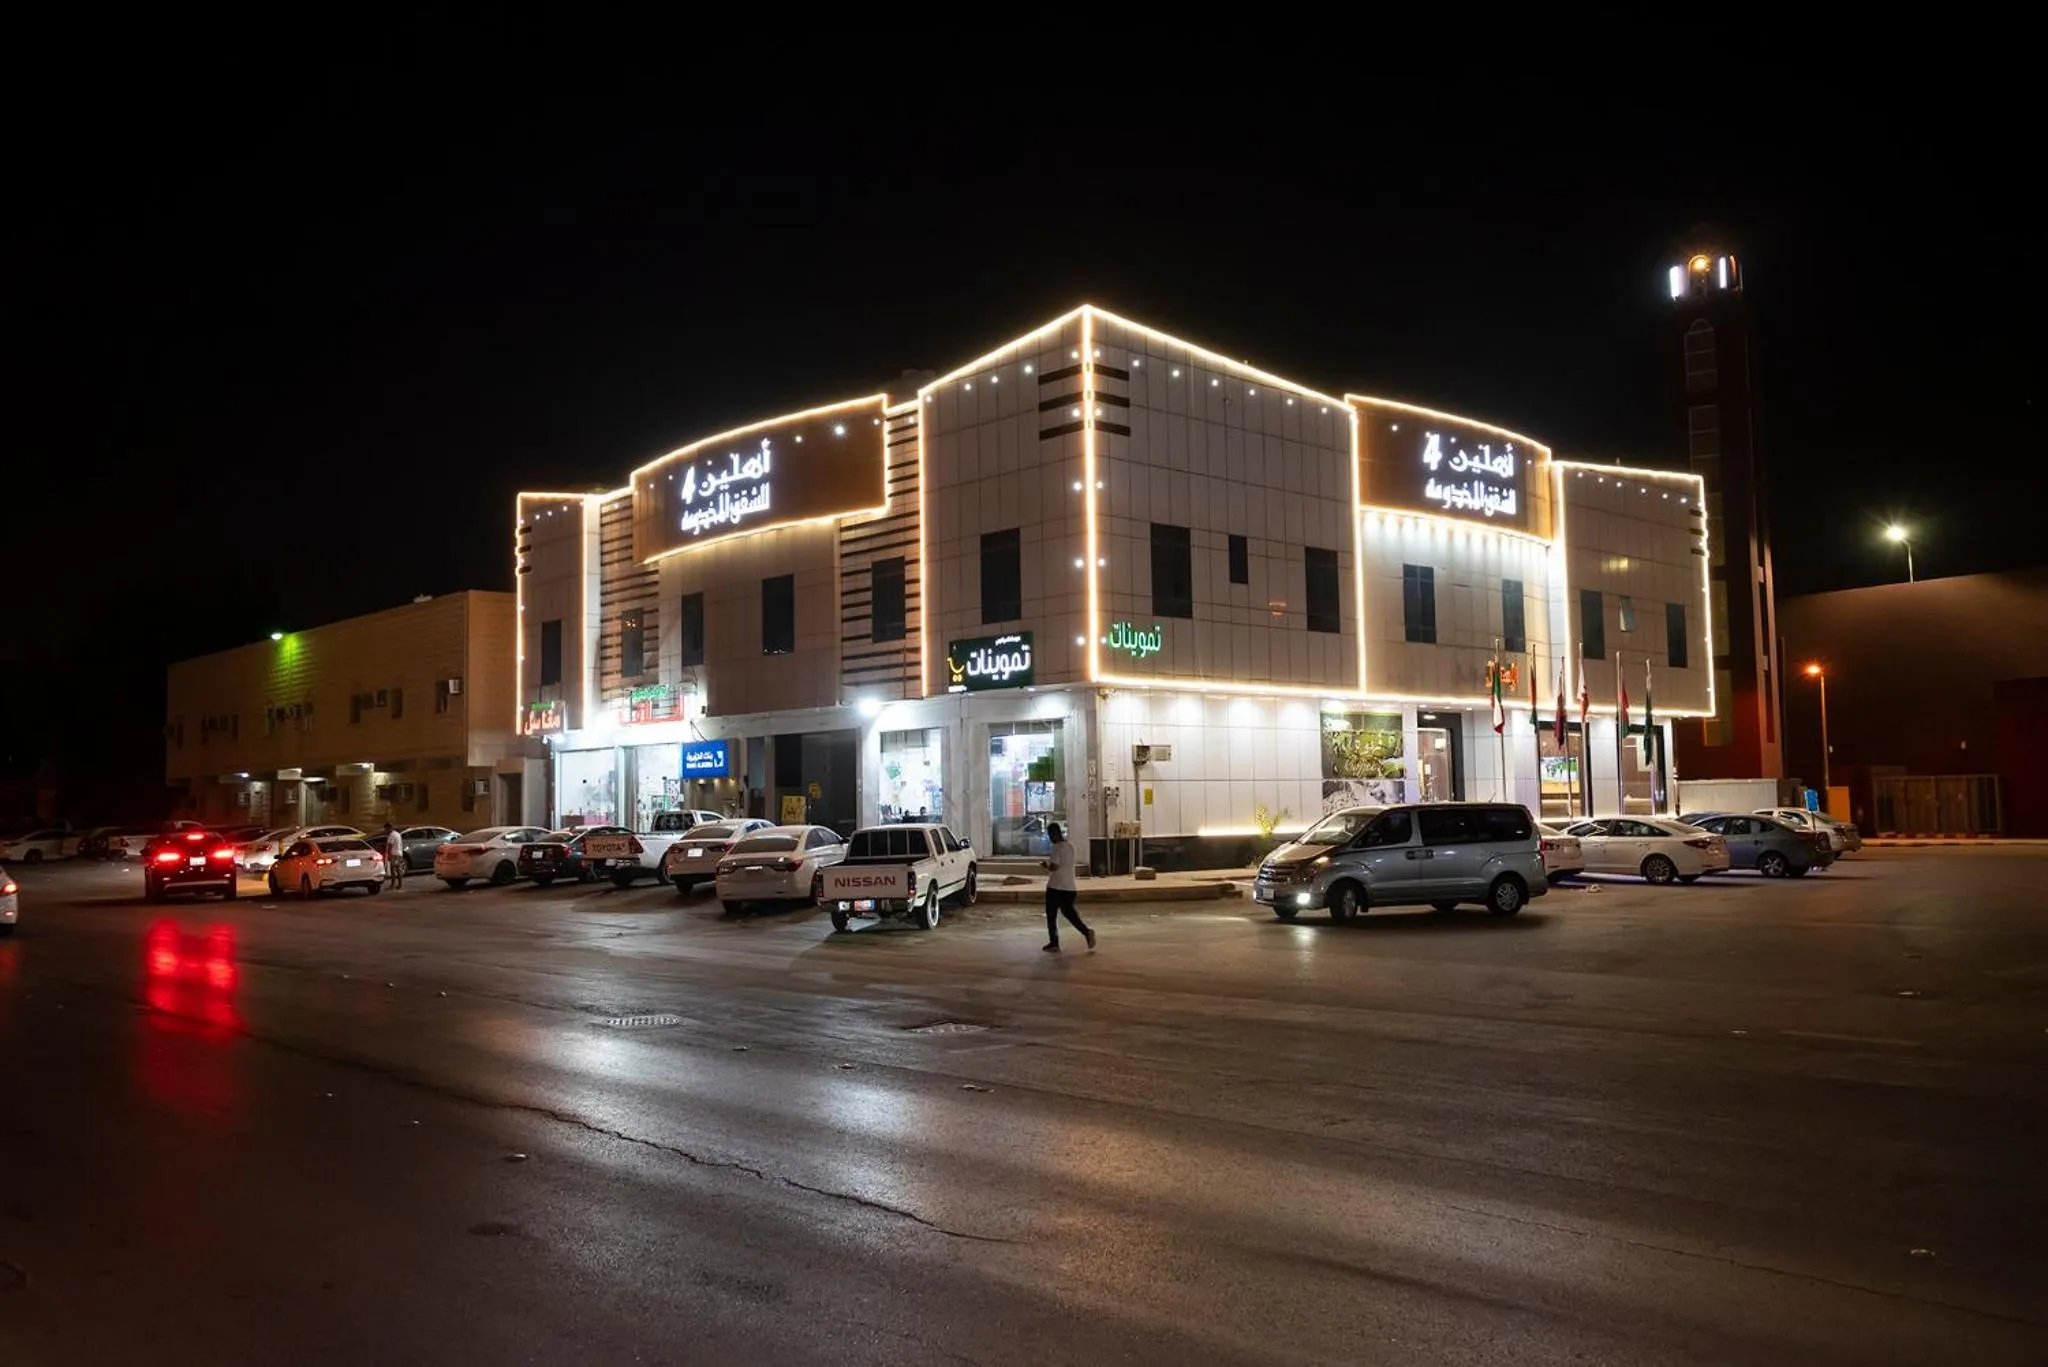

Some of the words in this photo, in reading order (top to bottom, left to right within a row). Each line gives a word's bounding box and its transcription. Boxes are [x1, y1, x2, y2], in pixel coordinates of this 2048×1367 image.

[699, 438, 770, 497] أهلين
[1423, 433, 1442, 470] 4
[1448, 443, 1514, 478] أهلين
[1109, 621, 1161, 658] تموينات
[967, 644, 1032, 680] تموينات
[592, 842, 622, 853] TOYOTA
[834, 876, 896, 888] NISSAN
